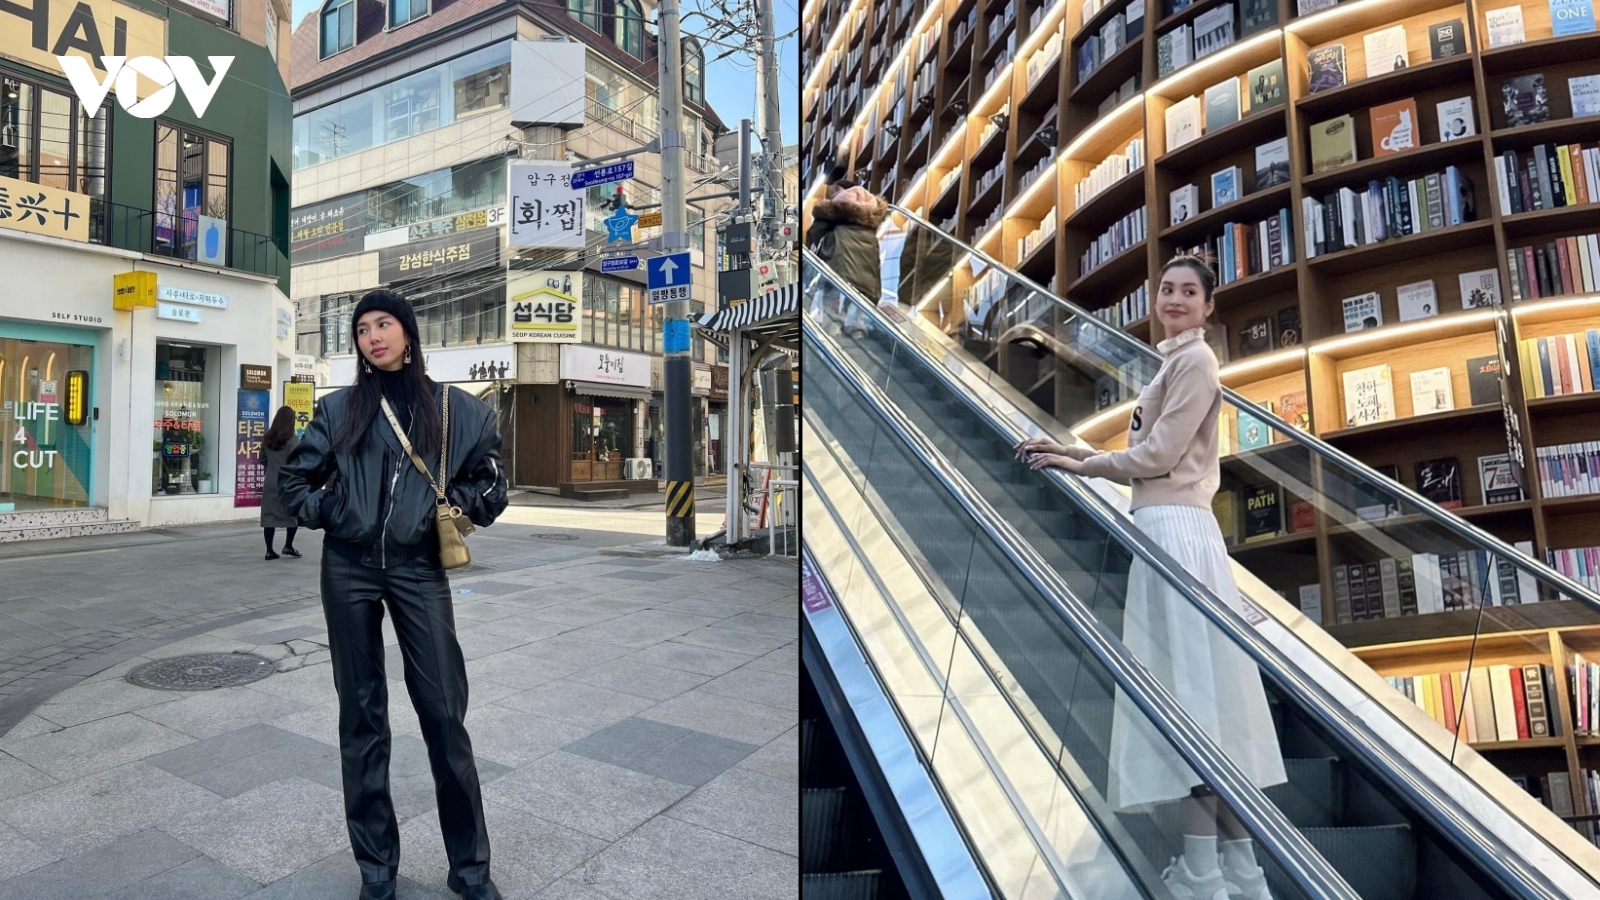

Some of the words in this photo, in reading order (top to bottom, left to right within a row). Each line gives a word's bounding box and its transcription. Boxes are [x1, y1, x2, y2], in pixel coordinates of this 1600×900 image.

[1556, 6, 1588, 20] ONE
[527, 172, 571, 187] 압구정
[410, 222, 431, 240] 소주
[432, 217, 454, 234] 맥주
[455, 210, 487, 232] 삼천원
[489, 207, 505, 223] 3F
[399, 243, 471, 271] 감성한식주점
[651, 286, 686, 301] 일방통행
[51, 312, 71, 320] SELF
[73, 314, 102, 323] STUDIO
[171, 308, 191, 317] 솔로몬
[512, 302, 576, 323] 섭식당
[14, 402, 59, 420] LIFE
[294, 411, 310, 427] 주
[1131, 405, 1143, 431] S
[13, 426, 27, 444] 4
[238, 420, 265, 438] 타로
[165, 444, 187, 454] 영업중
[13, 450, 58, 469] CUT
[1247, 493, 1275, 511] PATH
